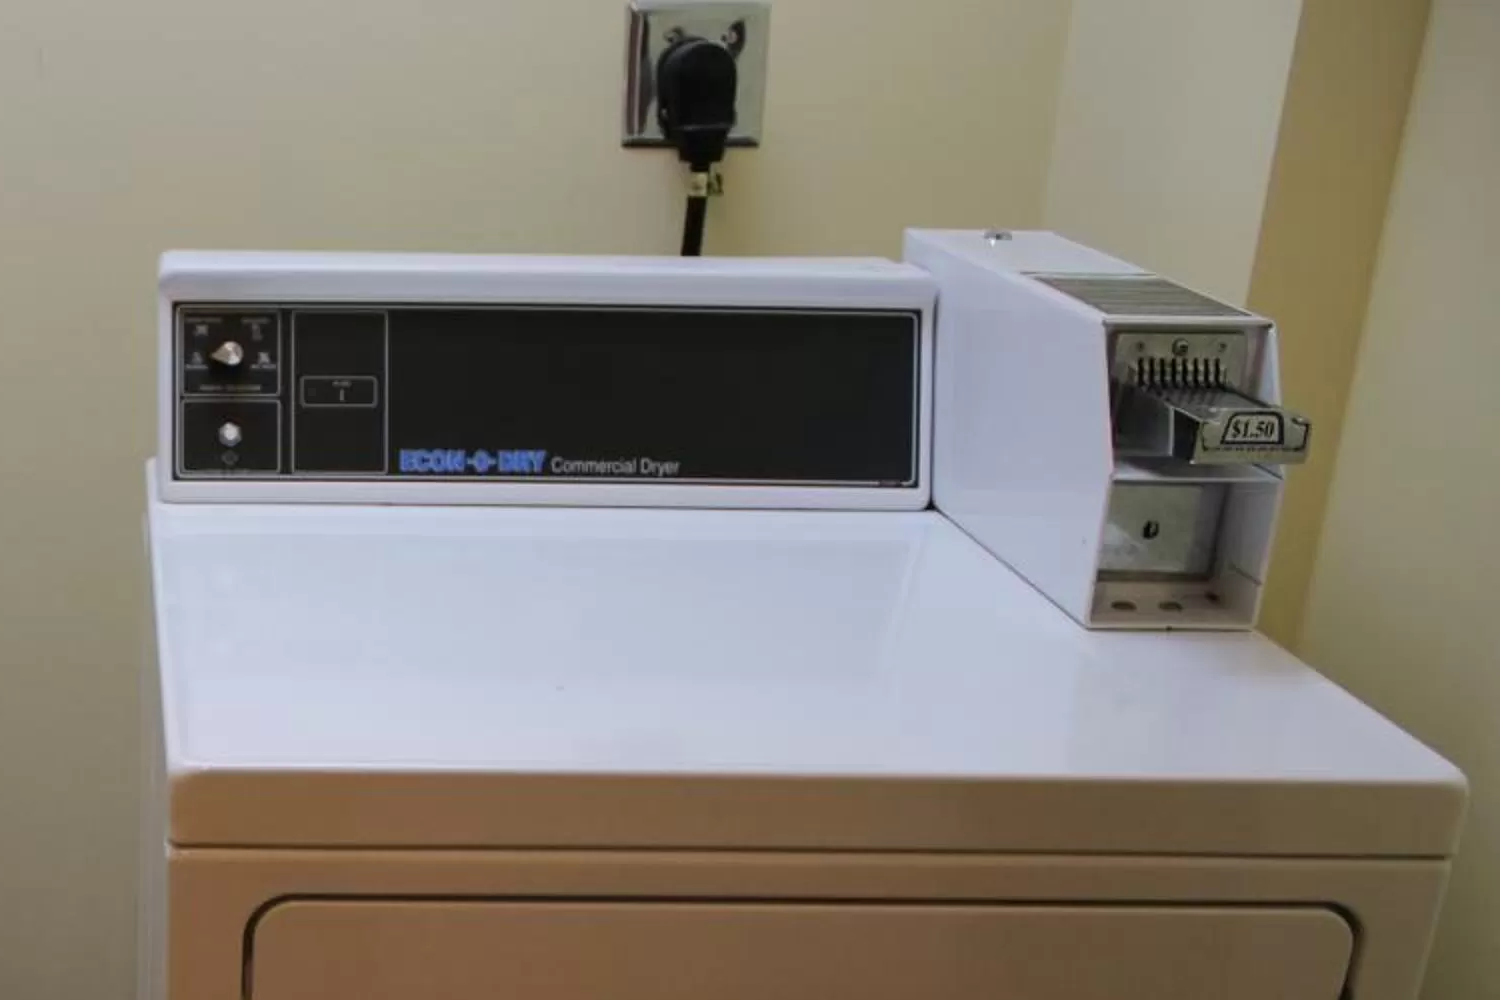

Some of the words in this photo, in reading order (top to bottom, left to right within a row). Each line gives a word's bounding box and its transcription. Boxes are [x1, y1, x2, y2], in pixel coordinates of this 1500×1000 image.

[1231, 418, 1275, 439] $1.50
[551, 456, 636, 474] Commercial
[640, 458, 680, 477] Dryer
